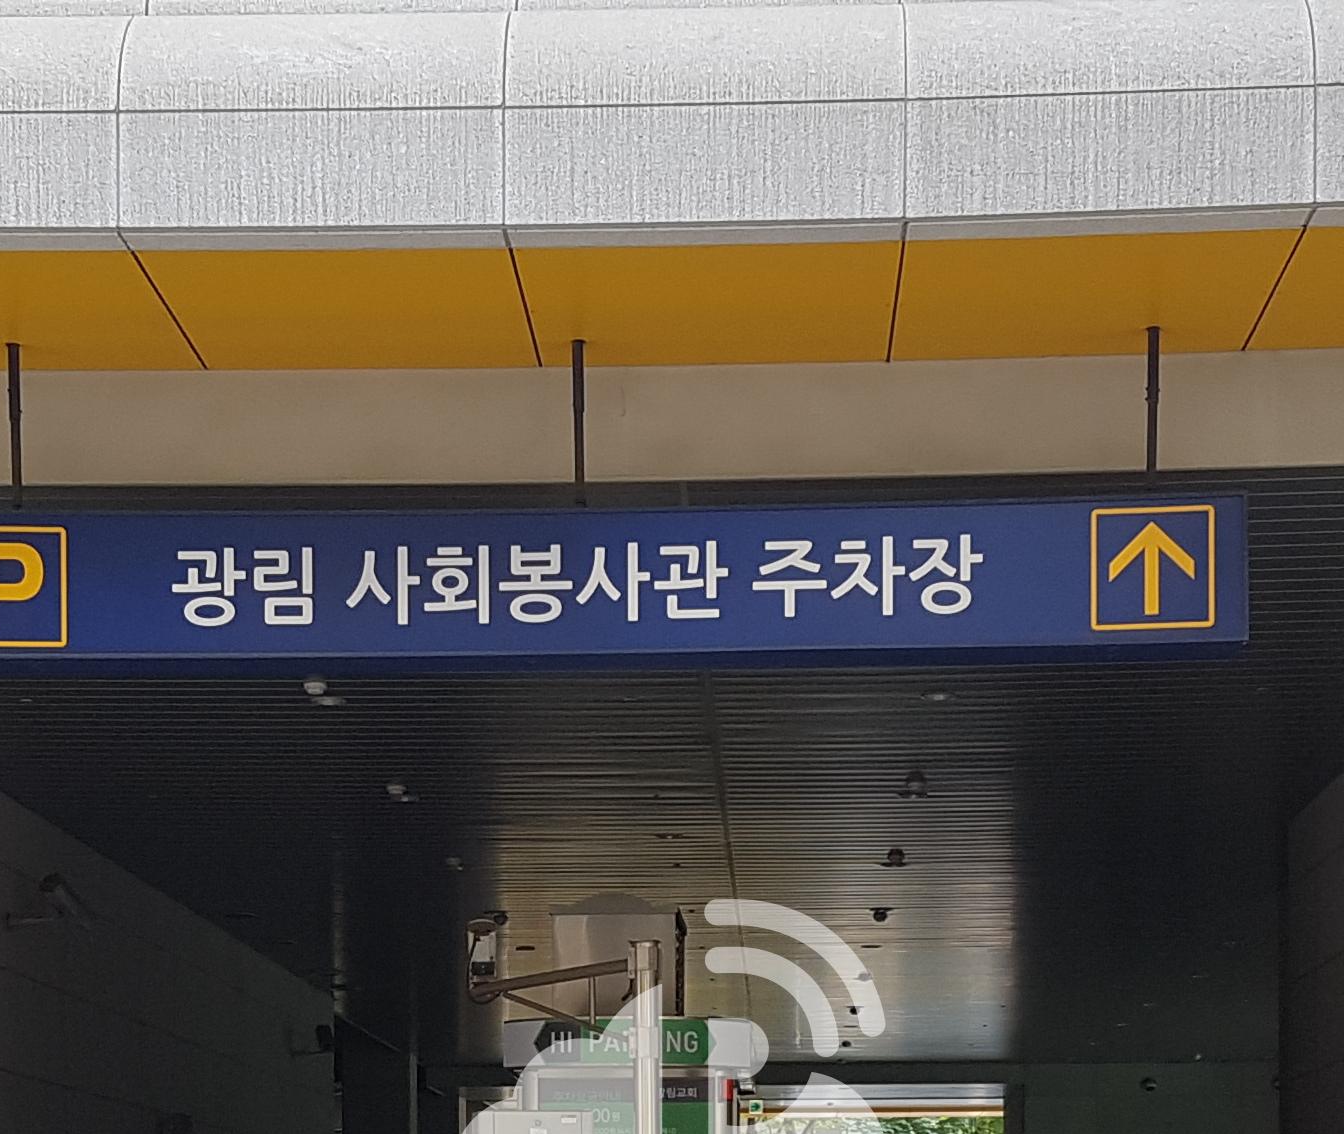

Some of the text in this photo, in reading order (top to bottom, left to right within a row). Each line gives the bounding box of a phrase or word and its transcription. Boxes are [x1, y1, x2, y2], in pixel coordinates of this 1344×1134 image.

[171, 546, 313, 628] 광림
[346, 540, 729, 627] 사회봉사관
[752, 534, 984, 619] 주차장
[550, 1031, 572, 1053] HI
